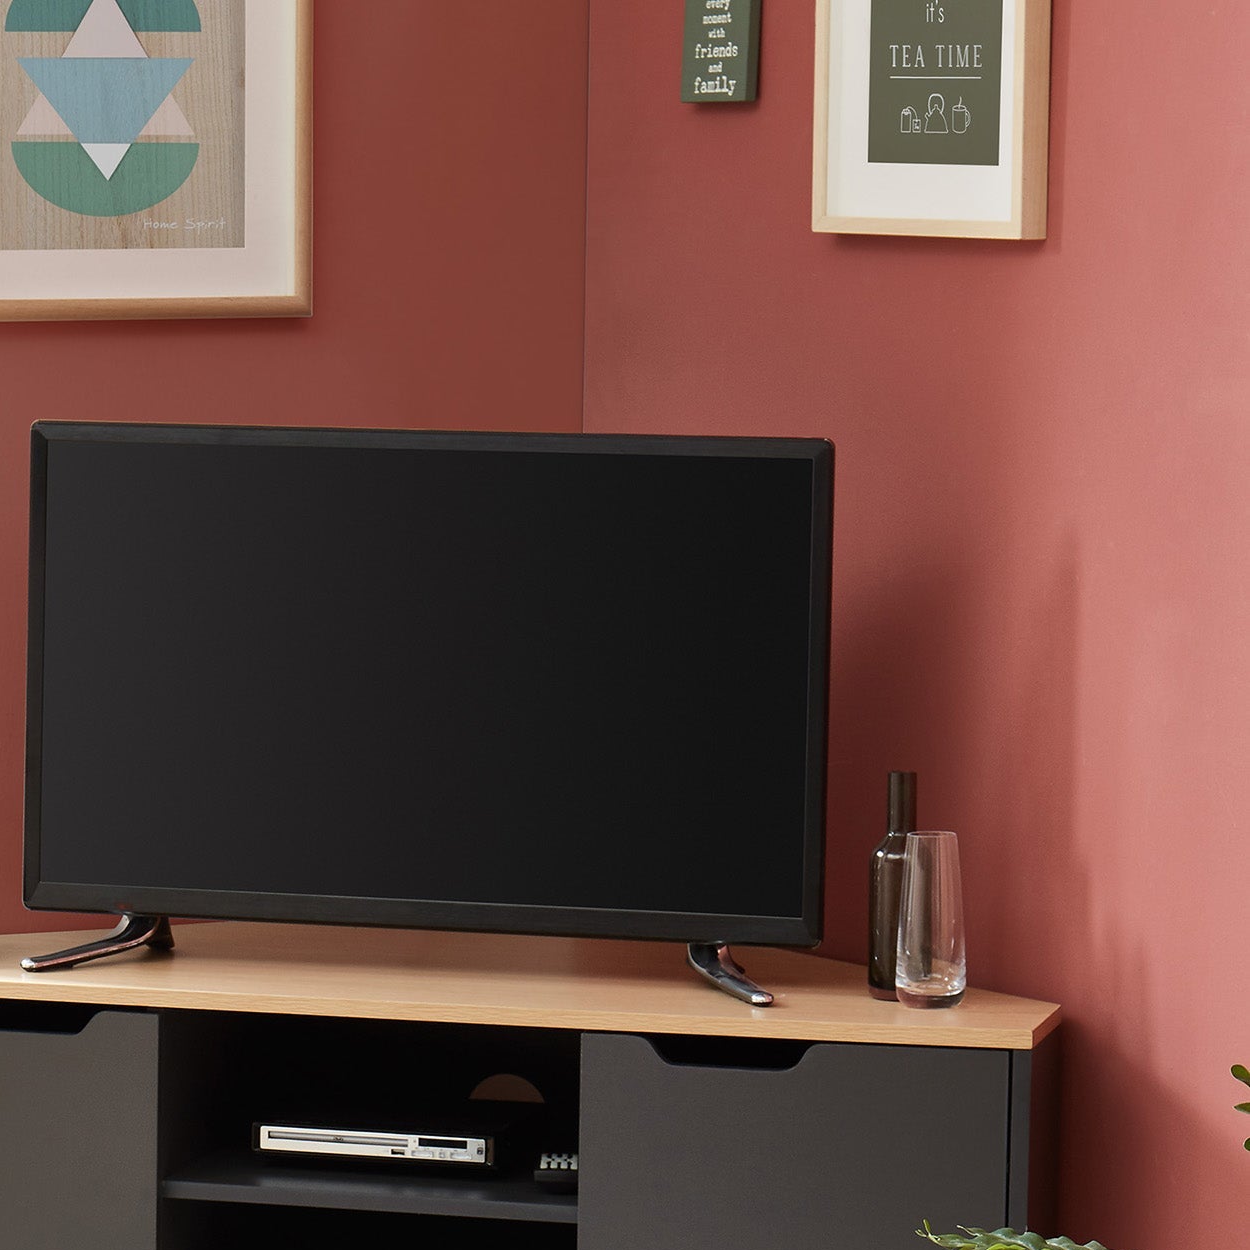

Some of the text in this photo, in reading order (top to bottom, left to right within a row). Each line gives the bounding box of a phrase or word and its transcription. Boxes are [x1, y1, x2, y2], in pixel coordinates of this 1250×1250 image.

[706, 0, 730, 10] every
[926, 0, 945, 23] it's
[703, 12, 732, 24] moment
[708, 28, 726, 38] with
[695, 42, 738, 58] friends
[889, 45, 982, 67] TEA TIME
[708, 61, 723, 72] and
[694, 76, 736, 96] family
[143, 217, 227, 235] Home Spirit
